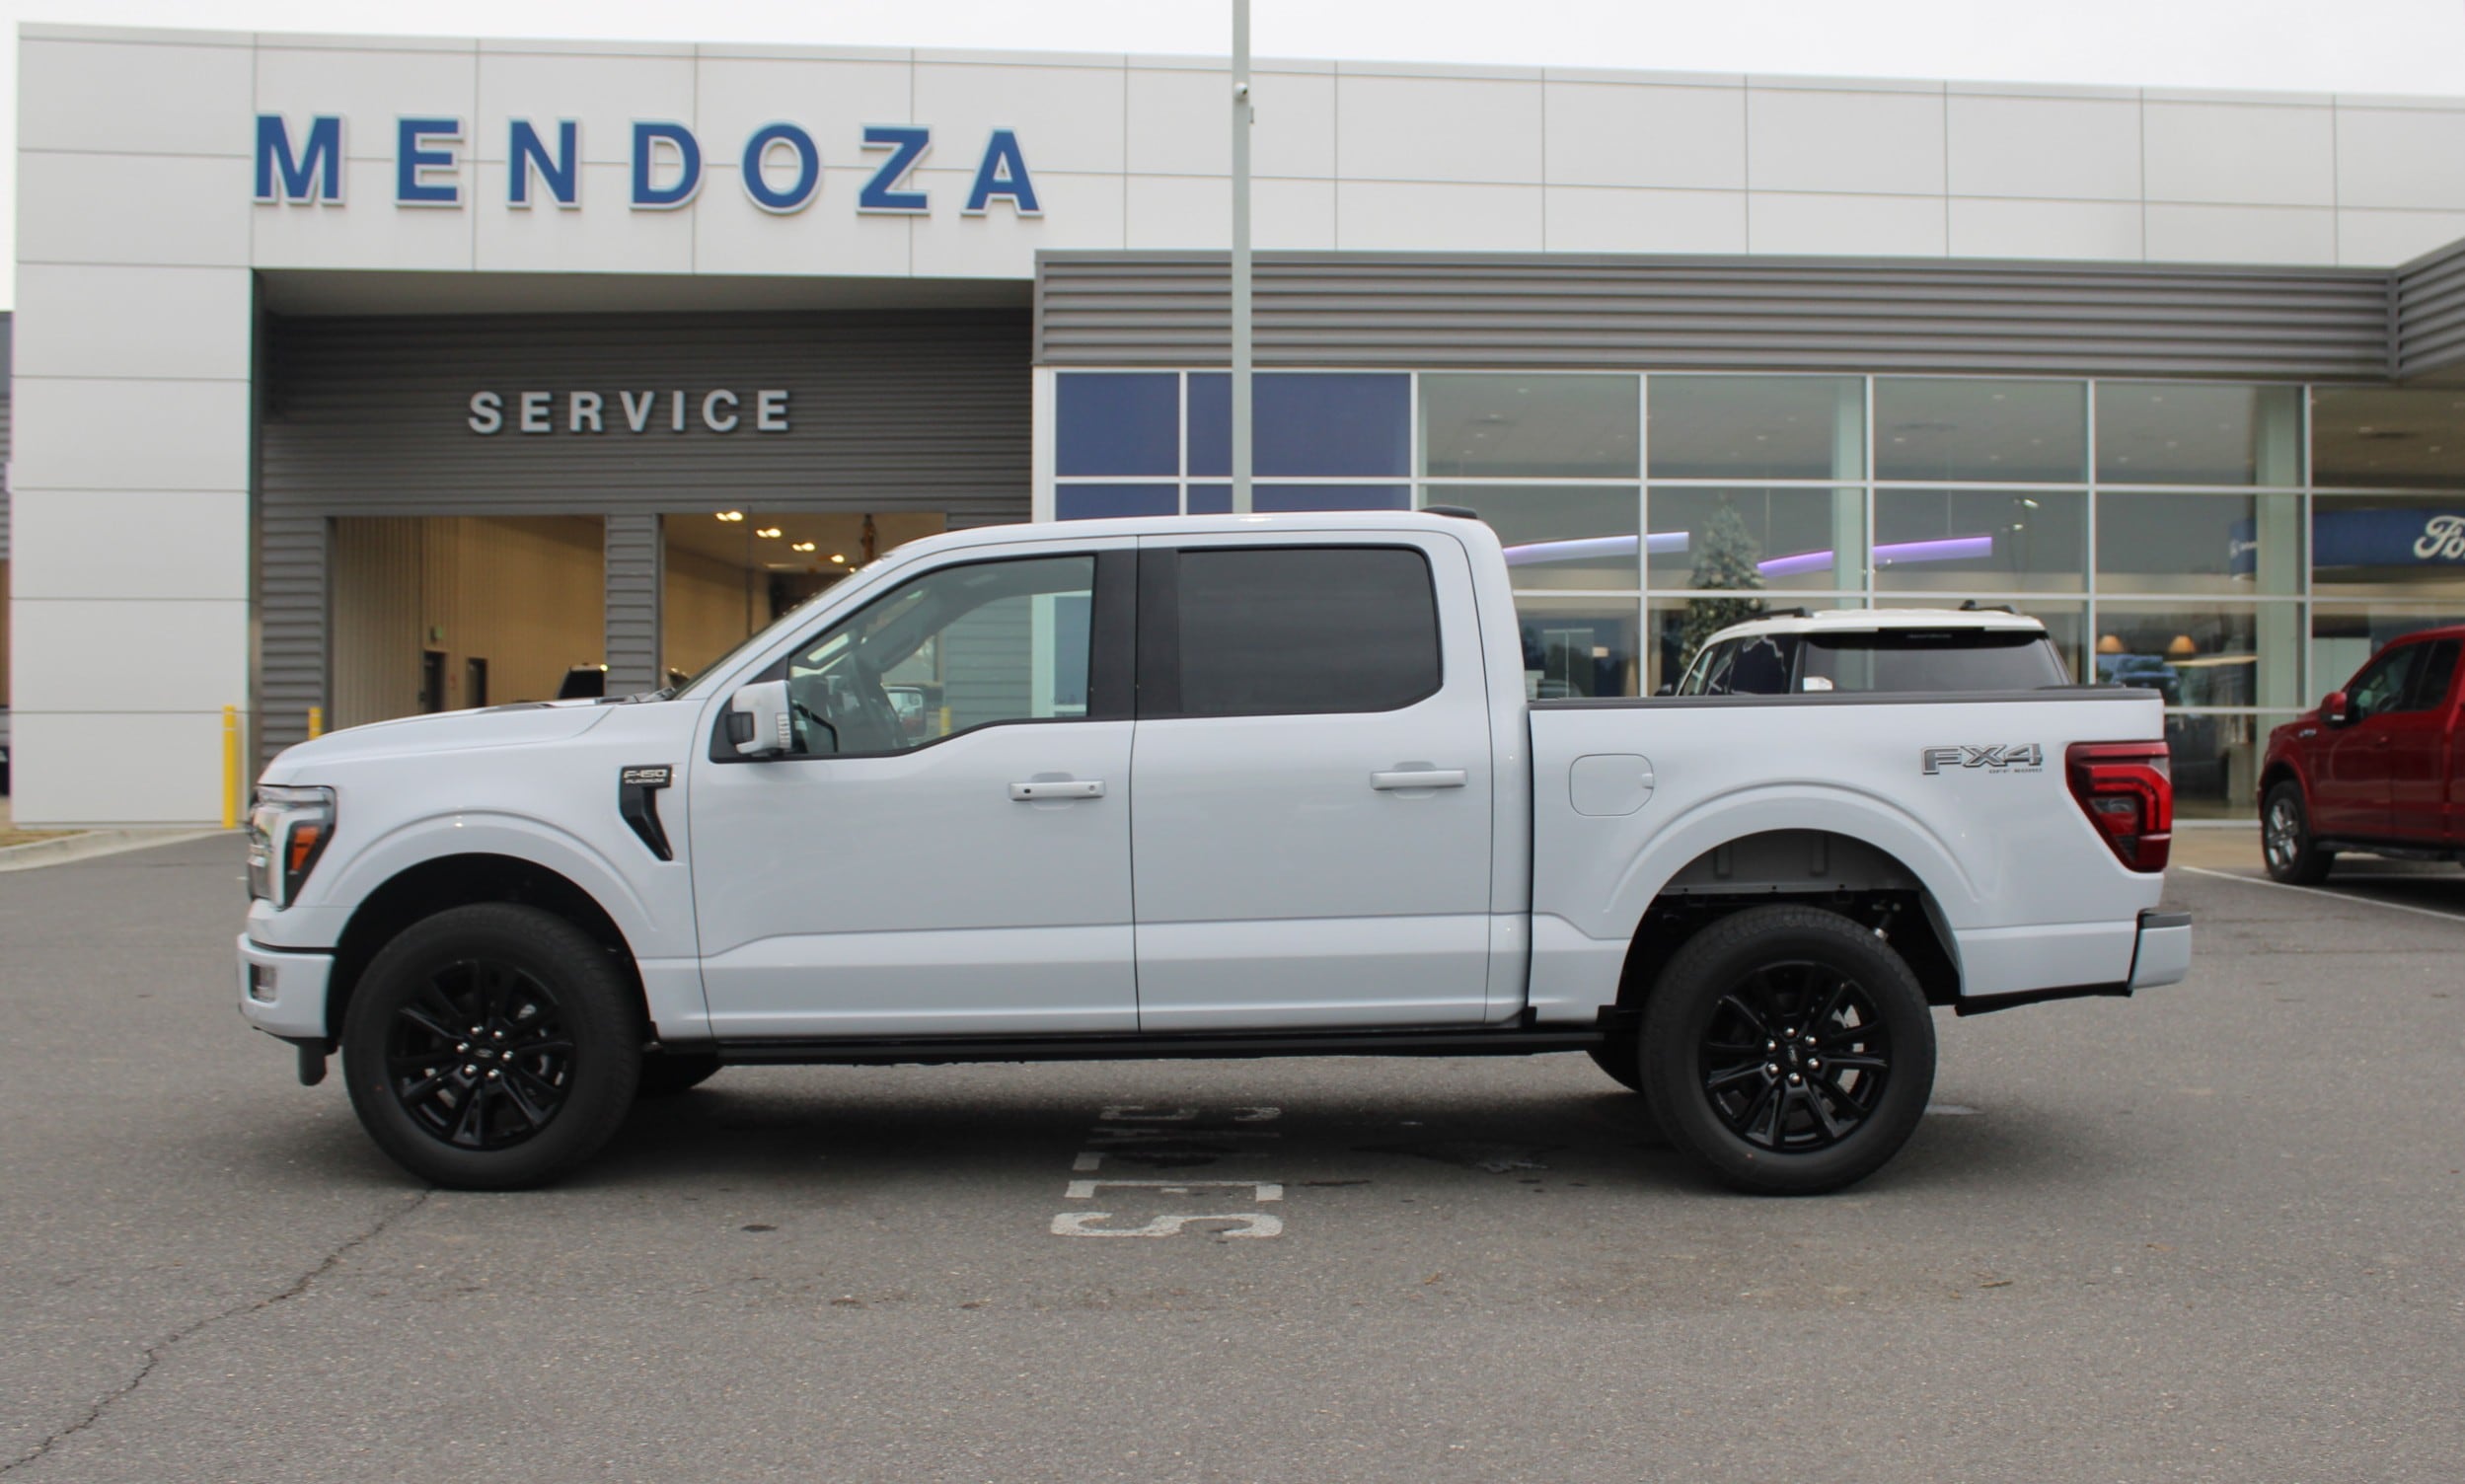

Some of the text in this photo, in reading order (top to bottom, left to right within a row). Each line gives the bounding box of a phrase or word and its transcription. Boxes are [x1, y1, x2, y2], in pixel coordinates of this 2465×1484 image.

[255, 112, 1043, 215] MENDOZA
[469, 389, 789, 433] SERVICE
[624, 770, 668, 779] F-150
[1922, 743, 2043, 775] FX4
